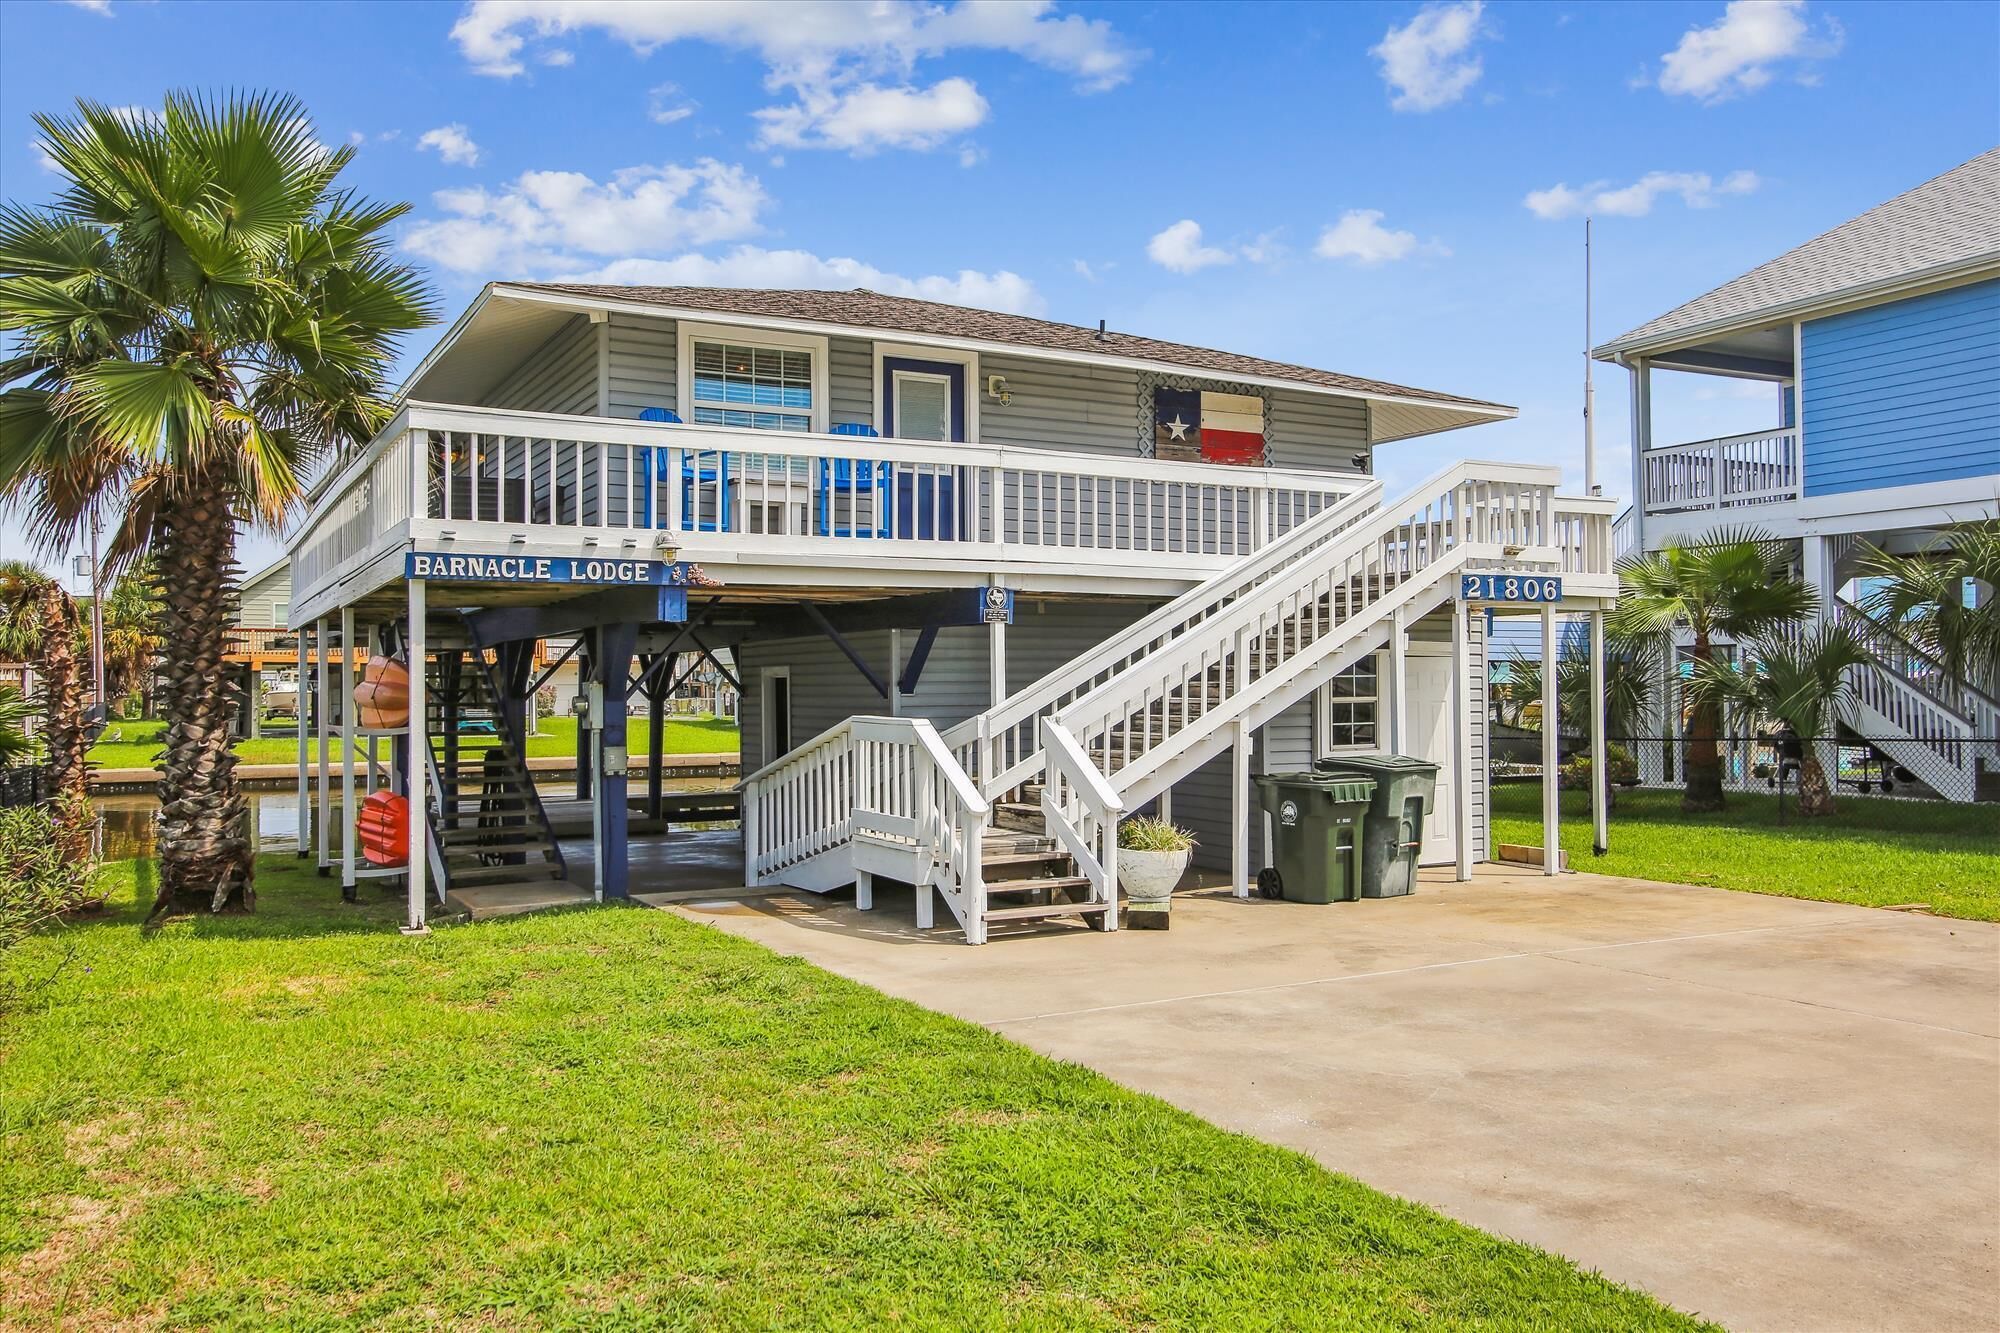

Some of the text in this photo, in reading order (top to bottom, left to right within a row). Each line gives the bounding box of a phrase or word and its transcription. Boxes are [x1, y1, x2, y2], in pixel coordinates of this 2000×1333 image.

[414, 556, 649, 581] BARNACLE LODGE
[1467, 576, 1557, 600] 21806
